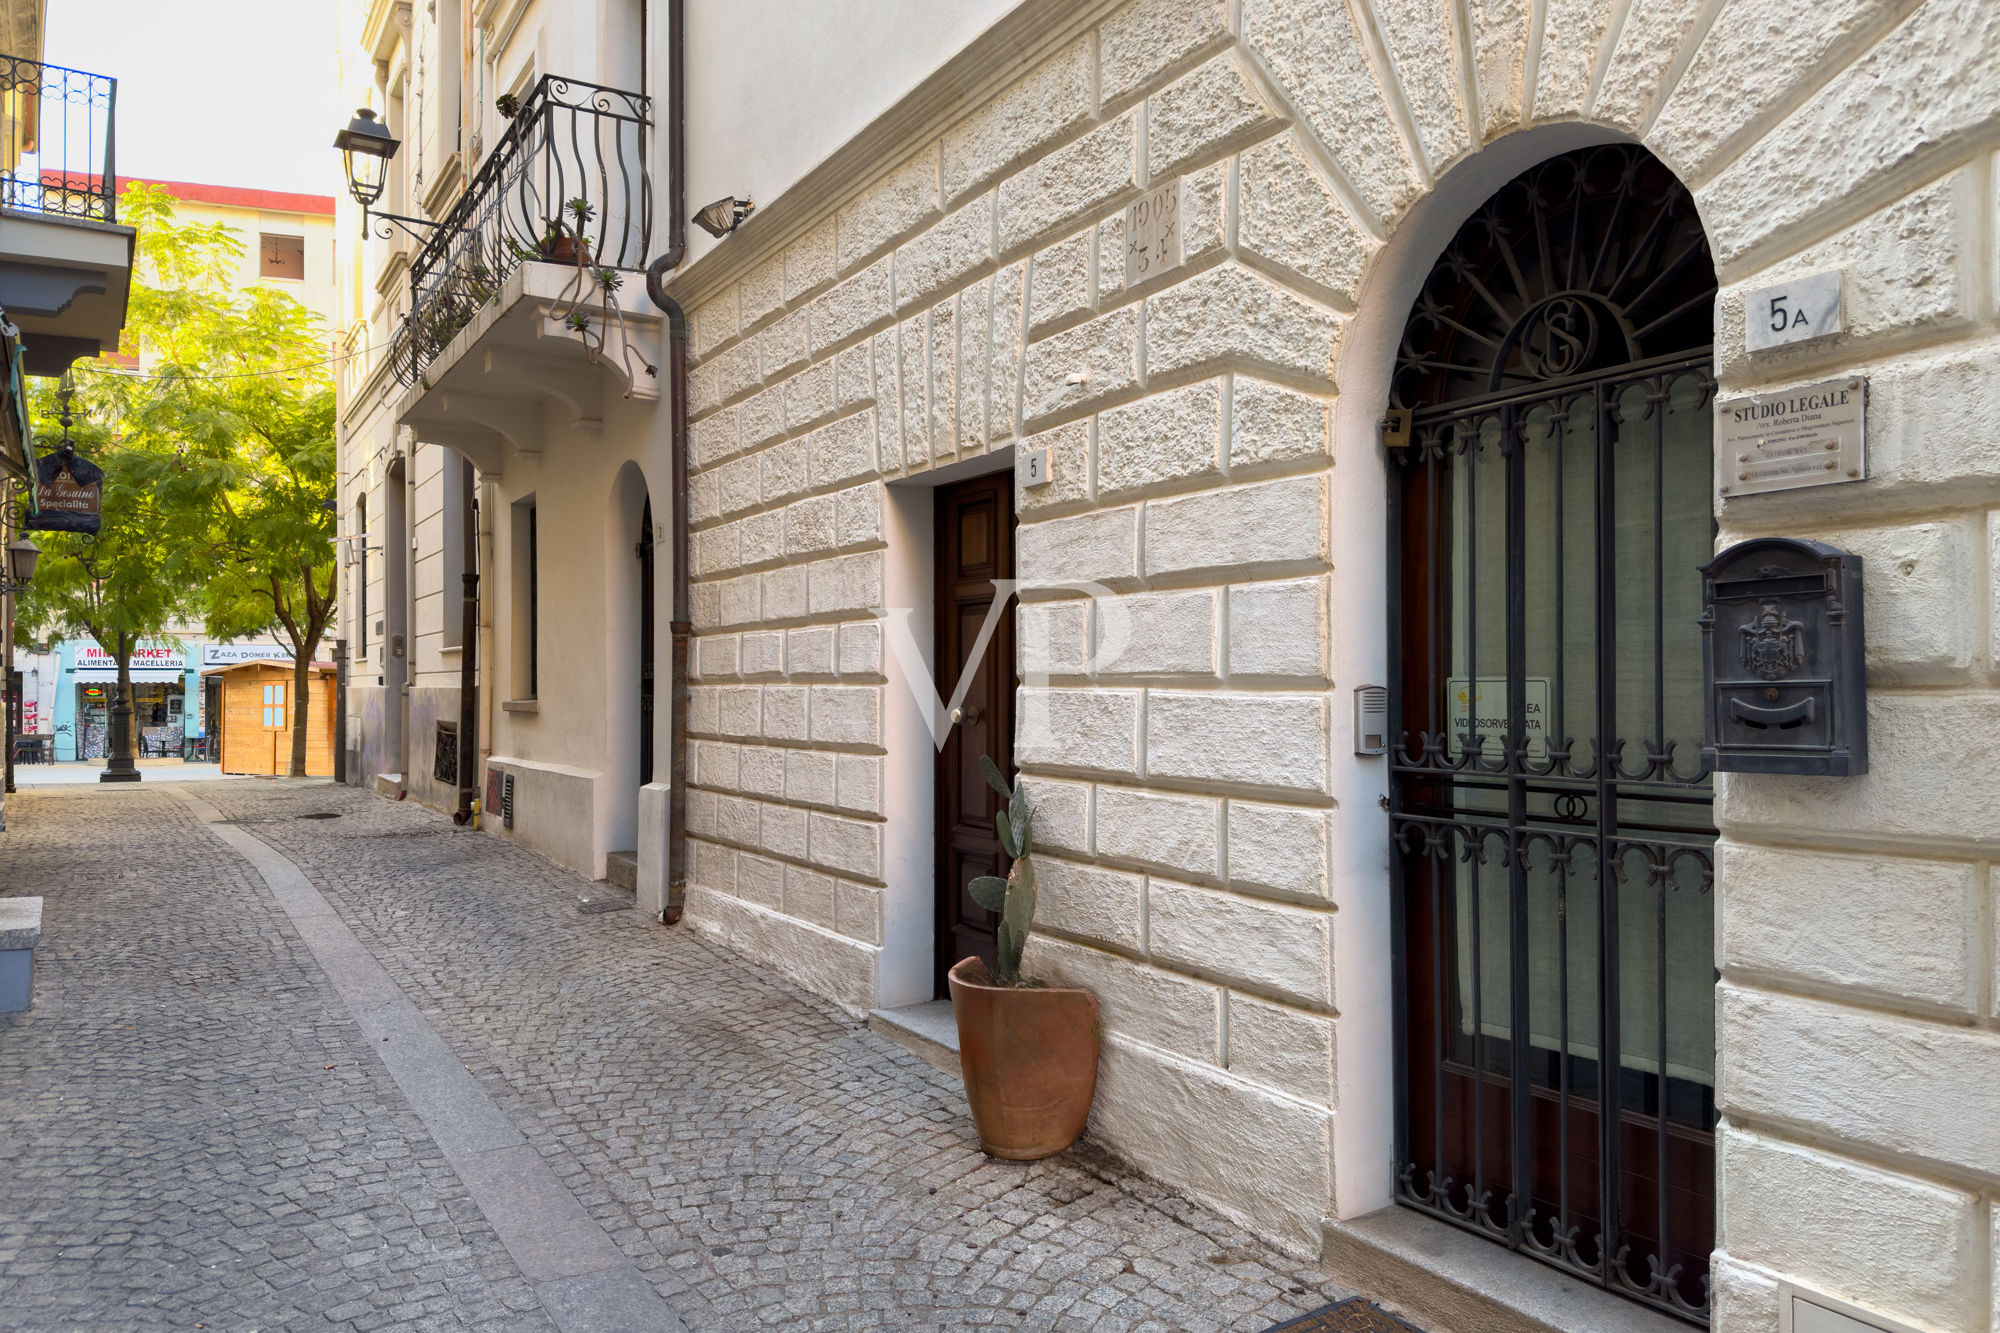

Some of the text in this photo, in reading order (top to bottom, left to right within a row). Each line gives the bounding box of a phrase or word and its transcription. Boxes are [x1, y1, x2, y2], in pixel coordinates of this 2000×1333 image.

[1734, 390, 1849, 423] STUDIO LEGALE
[1773, 415, 1800, 427] Roberta
[1801, 413, 1822, 423] Diana
[1031, 457, 1037, 478] 5
[40, 499, 89, 509] Specialità
